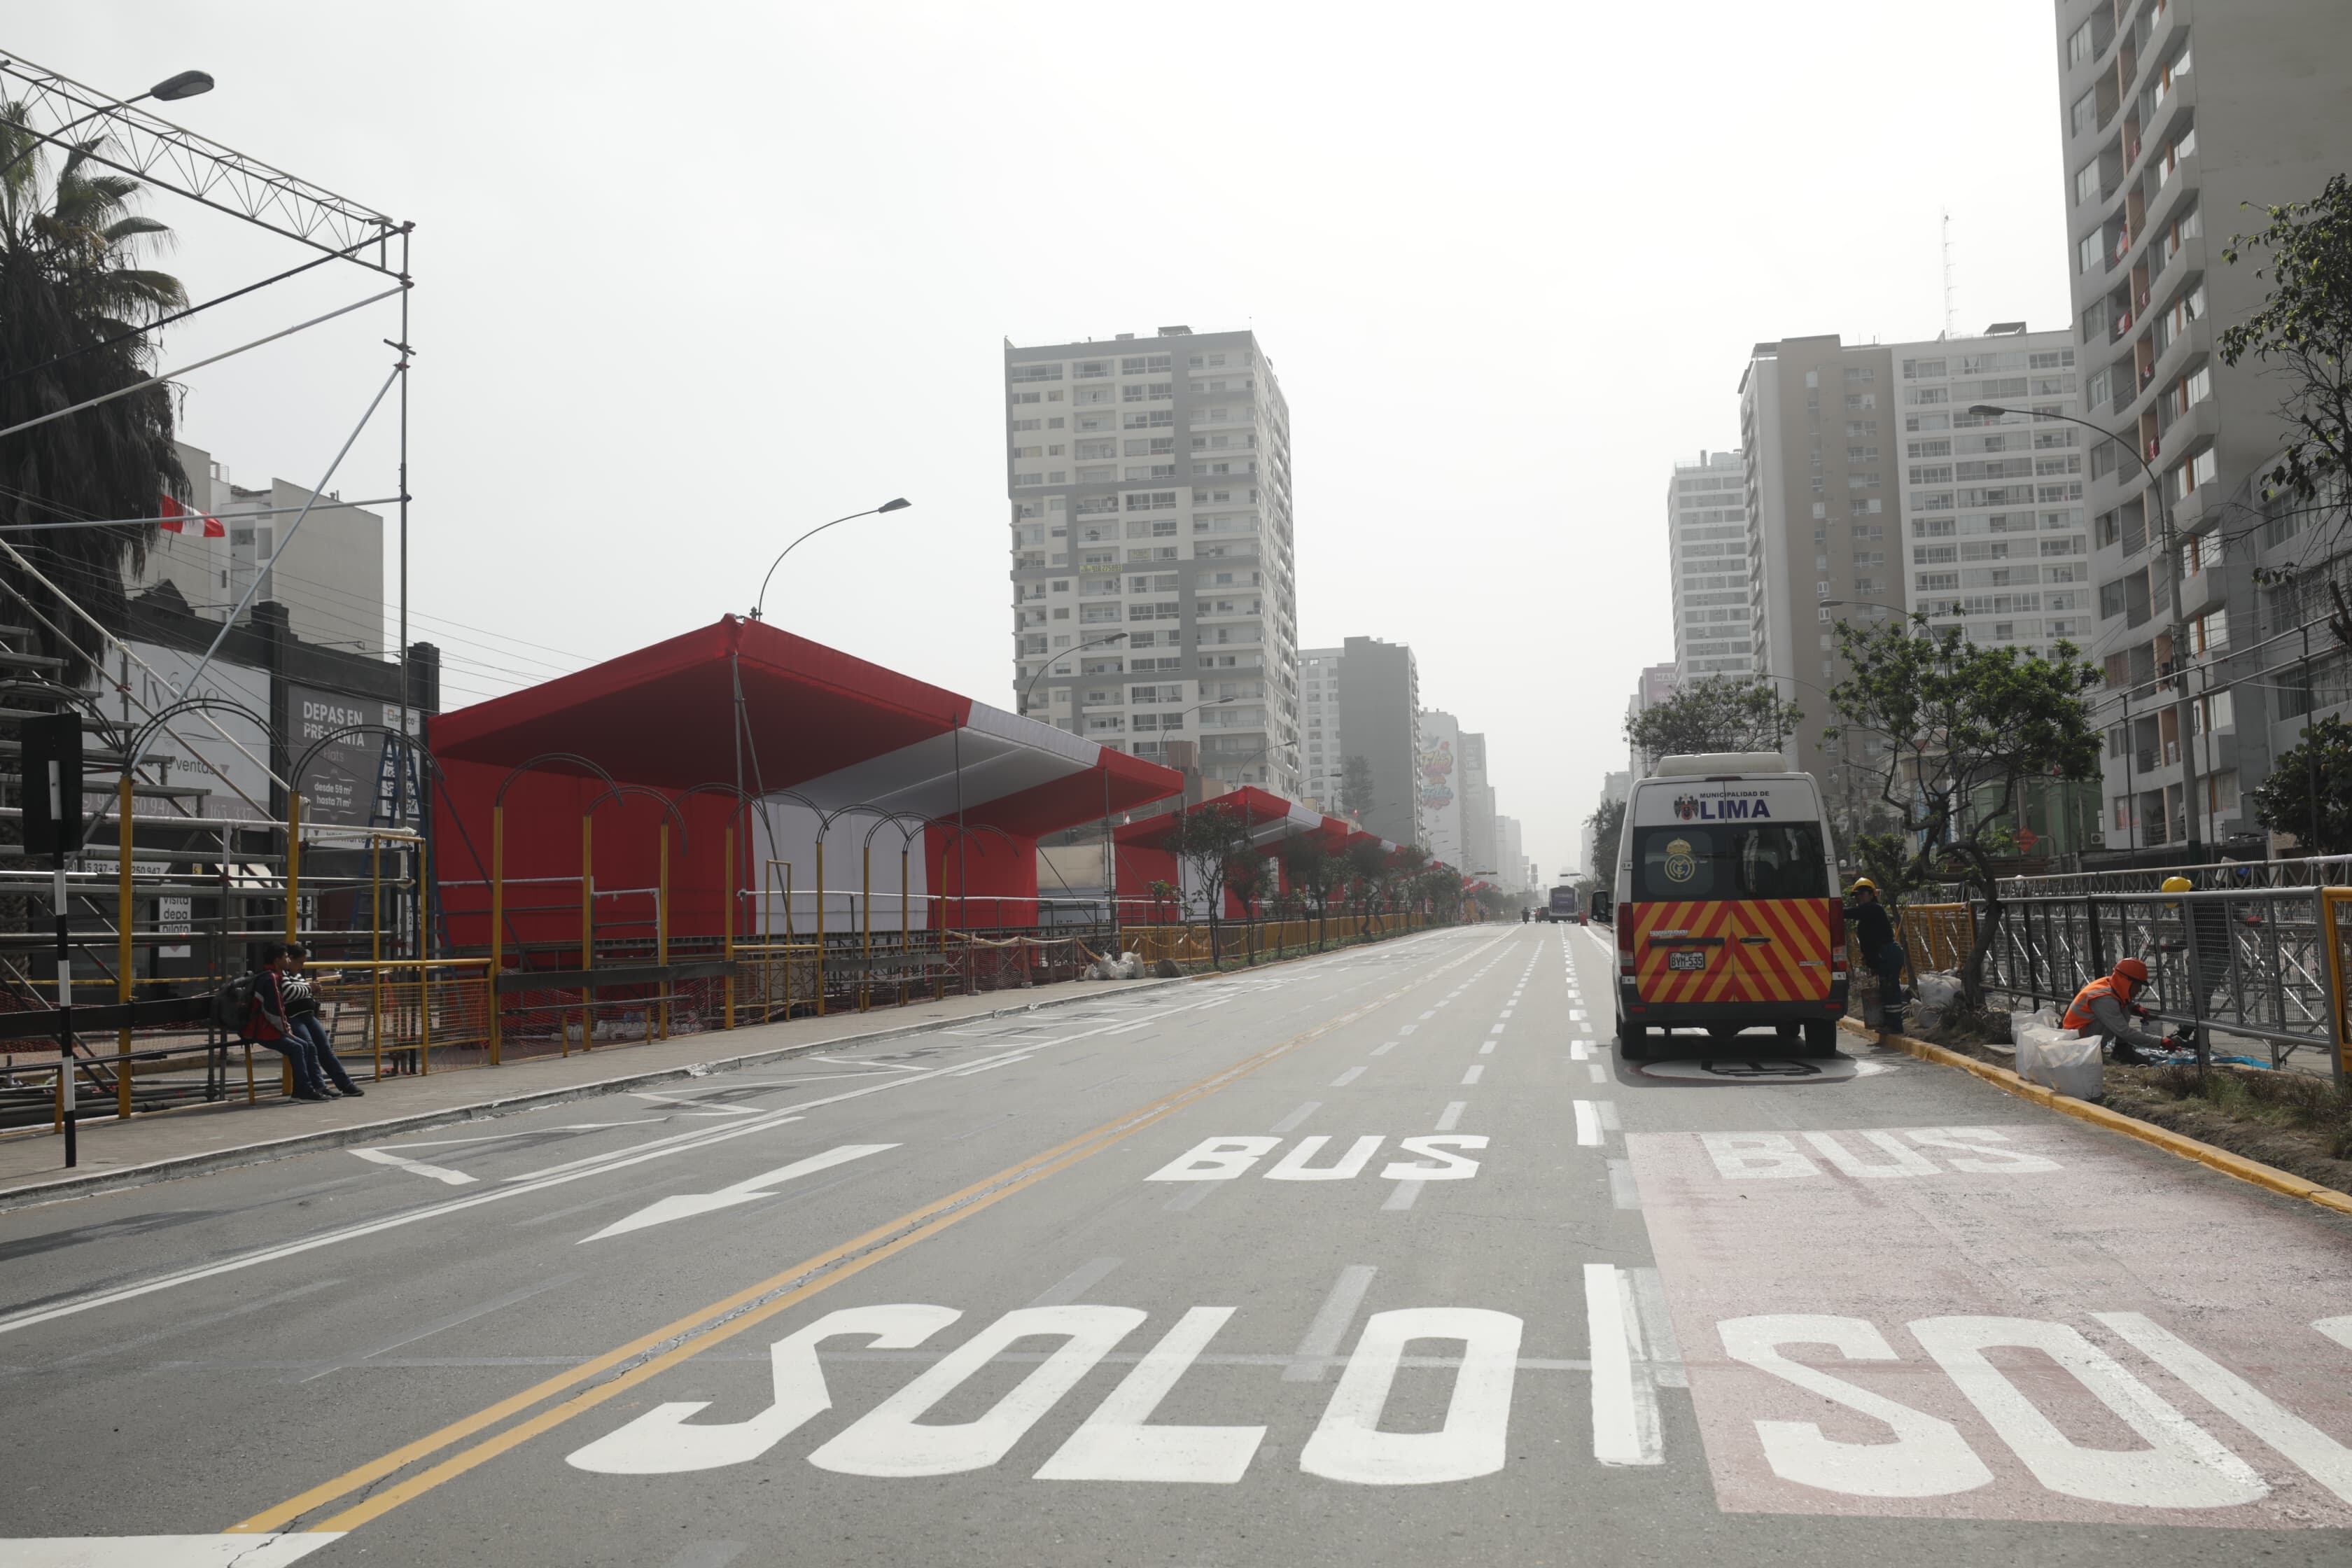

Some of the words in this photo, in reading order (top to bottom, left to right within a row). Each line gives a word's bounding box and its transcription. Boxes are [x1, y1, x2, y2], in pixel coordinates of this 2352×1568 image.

[303, 701, 344, 725] DEPAS
[347, 709, 363, 725] EN
[303, 722, 365, 747] PRE-VENTA
[314, 782, 334, 793] desde
[335, 783, 343, 794] 59
[316, 794, 335, 806] hasta
[1700, 799, 1771, 820] LIMA
[164, 908, 187, 919] depa
[1671, 956, 1703, 967] BYM-535
[1142, 1135, 1490, 1181] BUS
[1698, 1126, 2066, 1180] BUS
[564, 1303, 1524, 1485] SOLO
[1716, 1310, 2352, 1508] SOL
